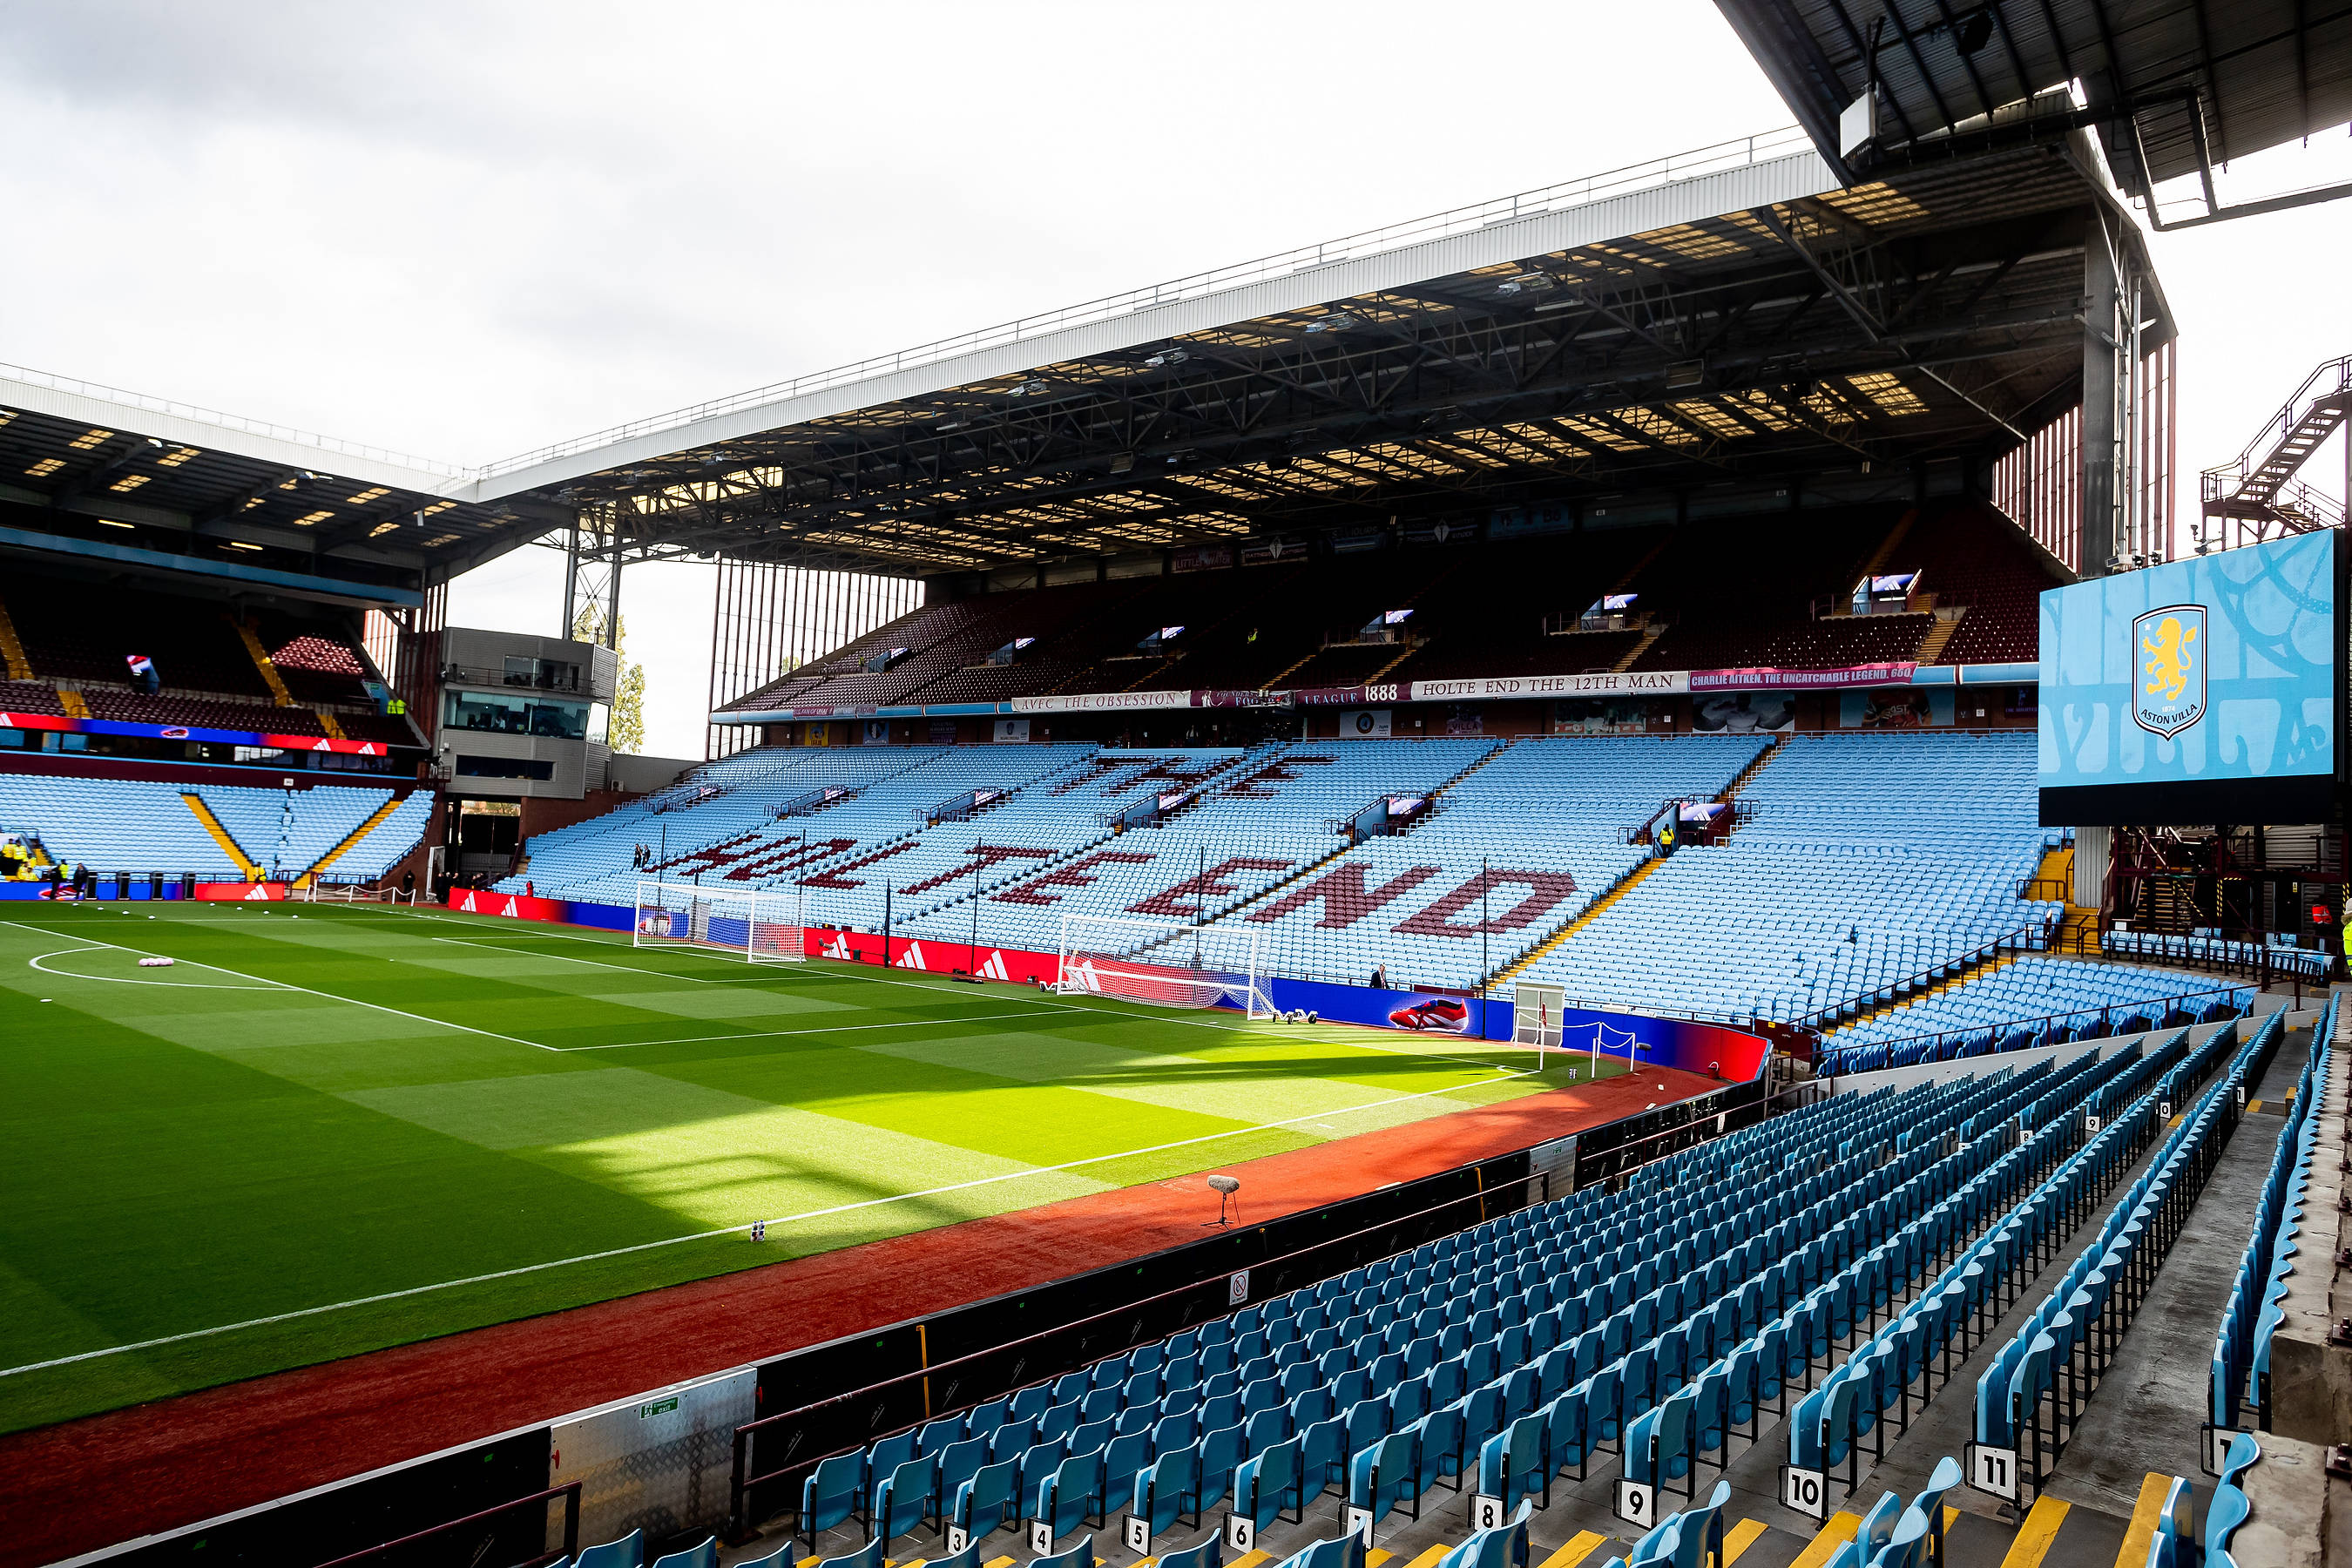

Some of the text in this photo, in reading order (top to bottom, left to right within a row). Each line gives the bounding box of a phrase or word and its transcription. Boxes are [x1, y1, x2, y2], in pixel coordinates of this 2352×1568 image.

[1423, 674, 1674, 696] HOLTE END THE 12TH MAN
[1692, 675, 1727, 686] CHARLIE
[1729, 673, 1763, 684] AITKEN.
[1765, 673, 1781, 683] THE
[1783, 671, 1849, 684] UNCATCHABLE
[1851, 669, 1889, 681] LEGEND.
[1021, 693, 1176, 710] AVFC THE OBSESSION
[1305, 684, 1398, 705] LEAGUE 1888
[2140, 703, 2198, 724] ASTON VILLA
[1123, 856, 1579, 938] END
[2160, 1105, 2169, 1115] 0
[2089, 1119, 2096, 1128] 9
[659, 1404, 671, 1414] exit
[1983, 1454, 2006, 1489] 11
[1791, 1474, 1820, 1506] 10
[1629, 1490, 1644, 1516] 9
[1483, 1504, 1494, 1529] 8
[954, 1533, 962, 1551] 3
[1037, 1530, 1046, 1549] 4
[1134, 1524, 1143, 1545] 5
[1236, 1523, 1247, 1545] 6
